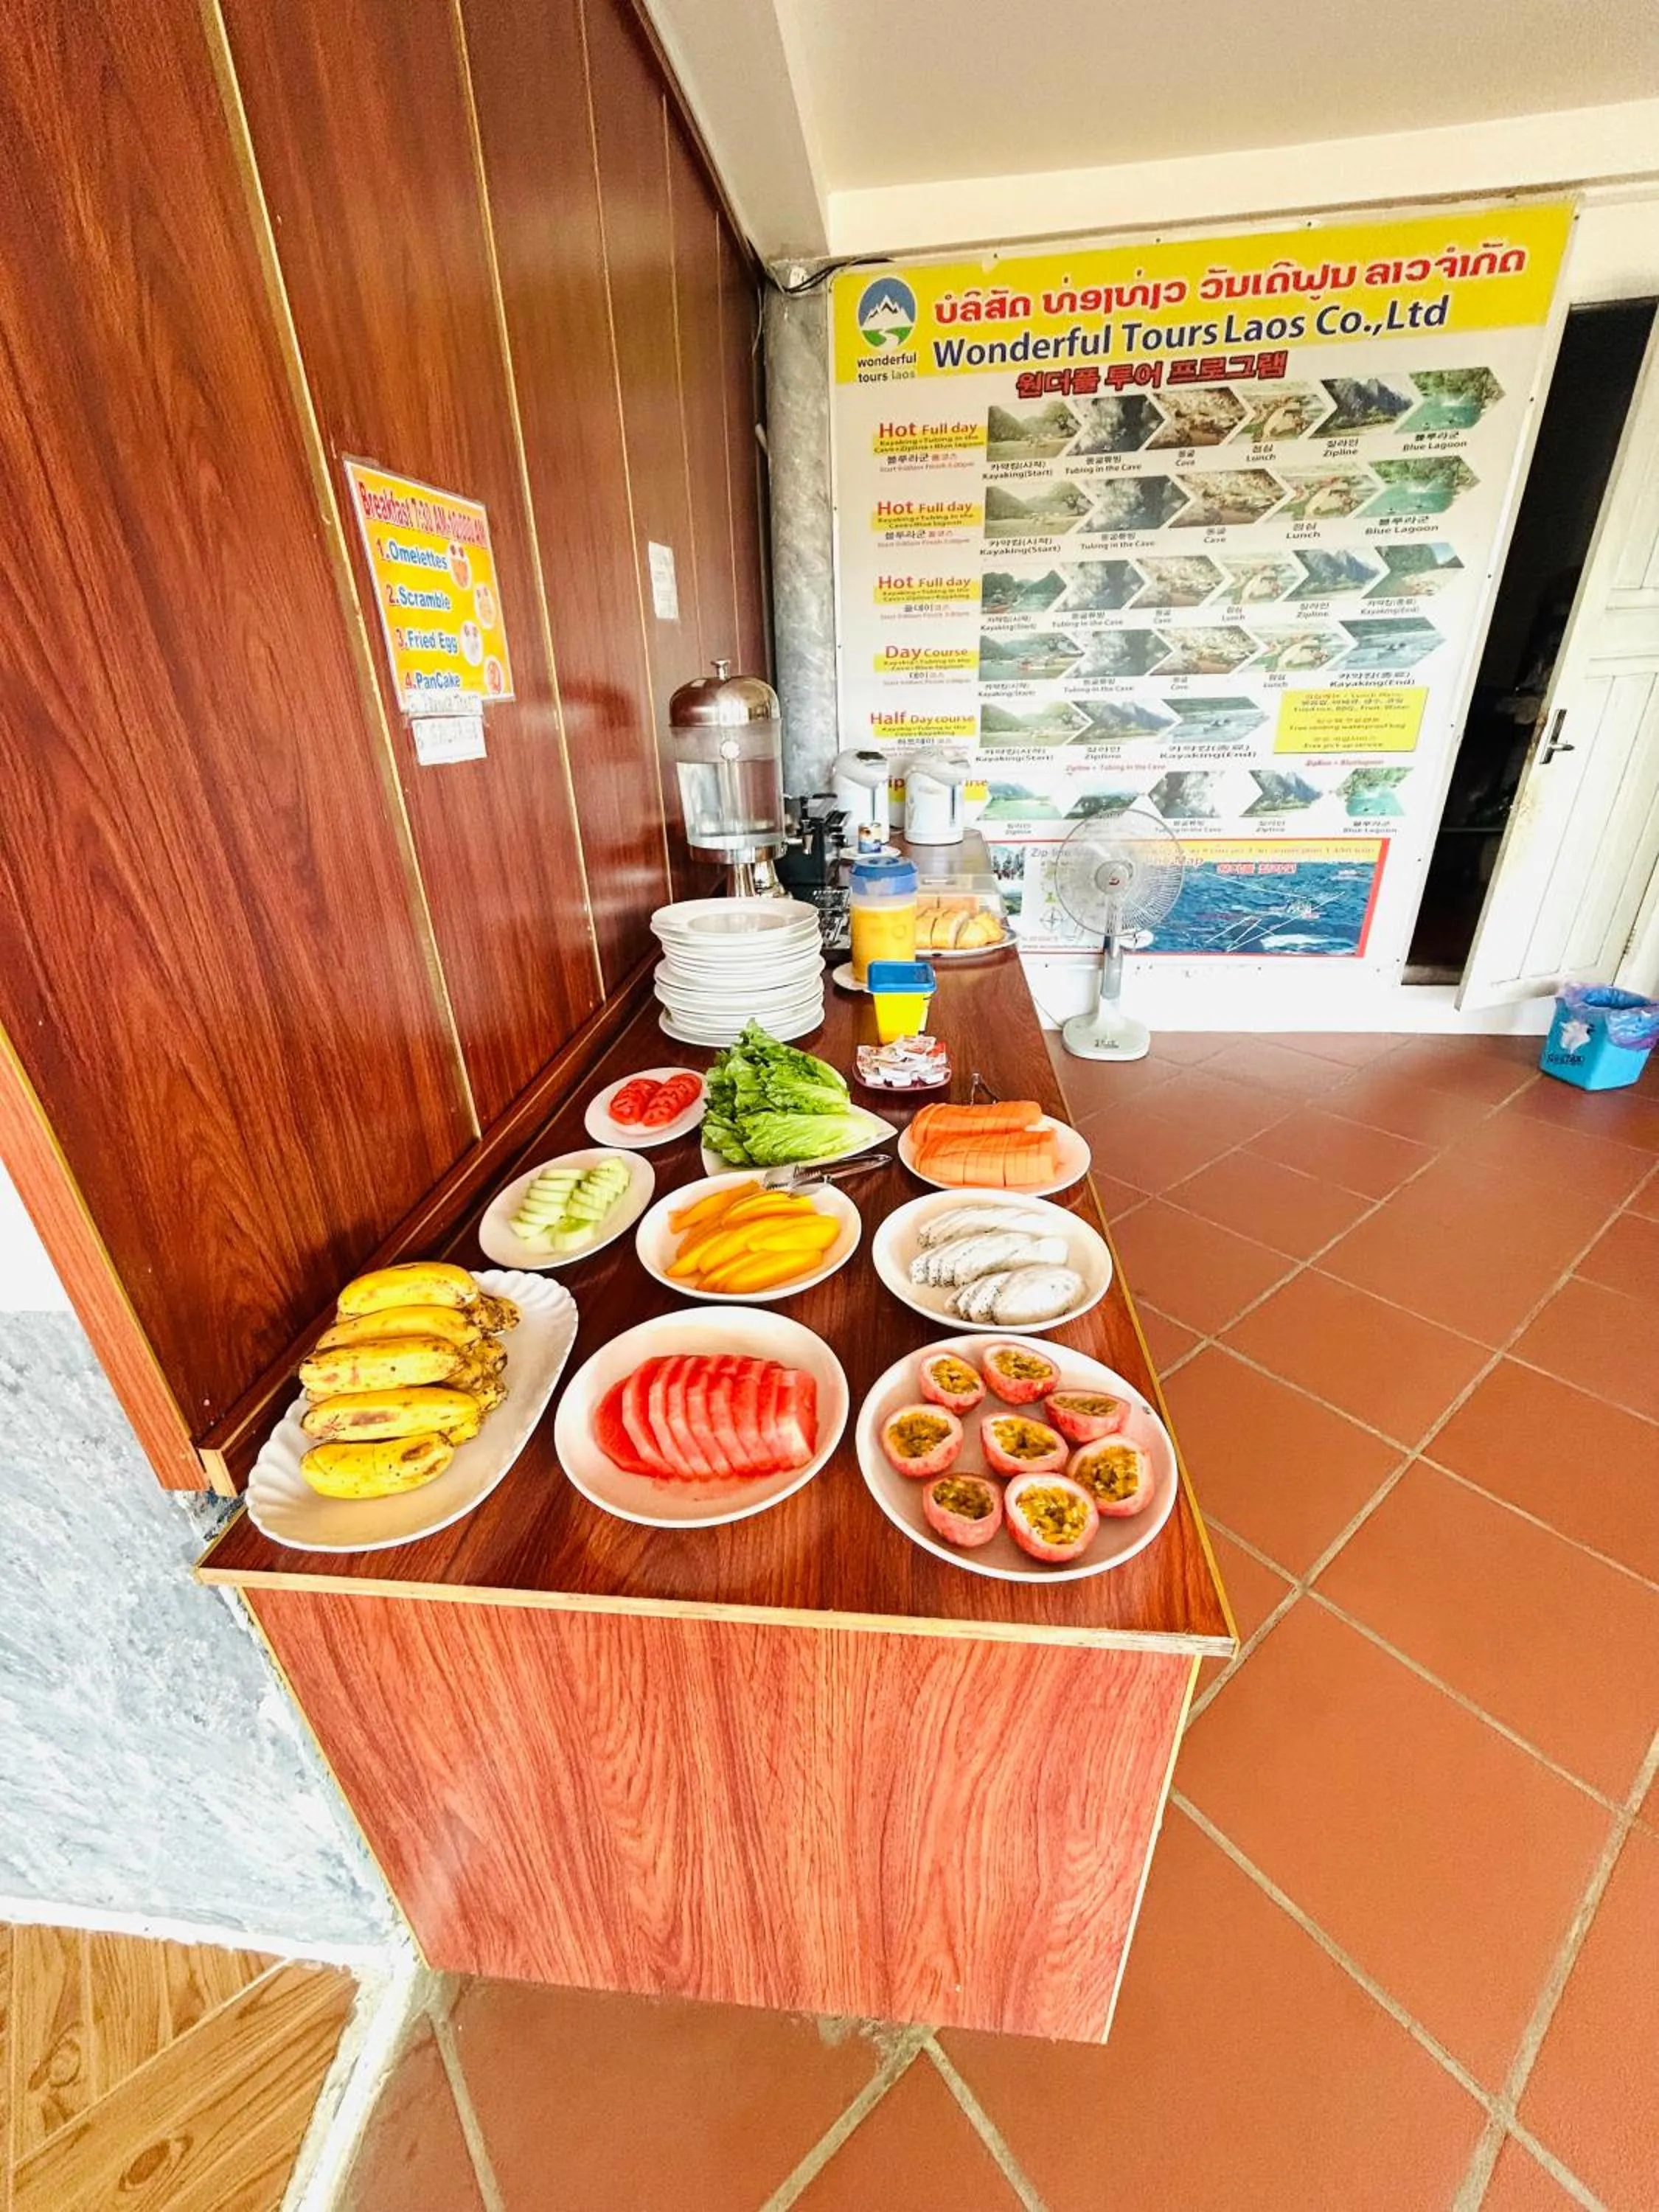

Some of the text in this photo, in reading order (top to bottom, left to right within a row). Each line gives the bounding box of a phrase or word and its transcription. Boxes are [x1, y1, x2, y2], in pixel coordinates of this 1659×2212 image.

[933, 294, 1450, 367] Wonderful Tours Laos Co.,Ltd
[858, 352, 917, 367] wonderful
[858, 370, 915, 383] tours laos
[1015, 350, 1289, 398] 원더풀 투어 프로그램
[879, 422, 978, 438] Hot Full day
[1323, 448, 1359, 458] Zipline
[1402, 441, 1467, 452] Blue Lagoon
[1245, 453, 1276, 462] Lunch
[981, 469, 1053, 479] Kayaking(Start)
[1065, 466, 1093, 475] Tubing
[1106, 464, 1119, 472] the
[877, 501, 973, 516] Hot Full day
[1286, 530, 1321, 540] Lunch
[1365, 525, 1439, 535] Blue Lagoon
[980, 546, 1061, 556] Kayaking(Start)
[878, 575, 972, 589] Hot Full day
[439, 633, 458, 653] Egg
[885, 645, 922, 660] Day
[871, 711, 975, 725] Half Day course
